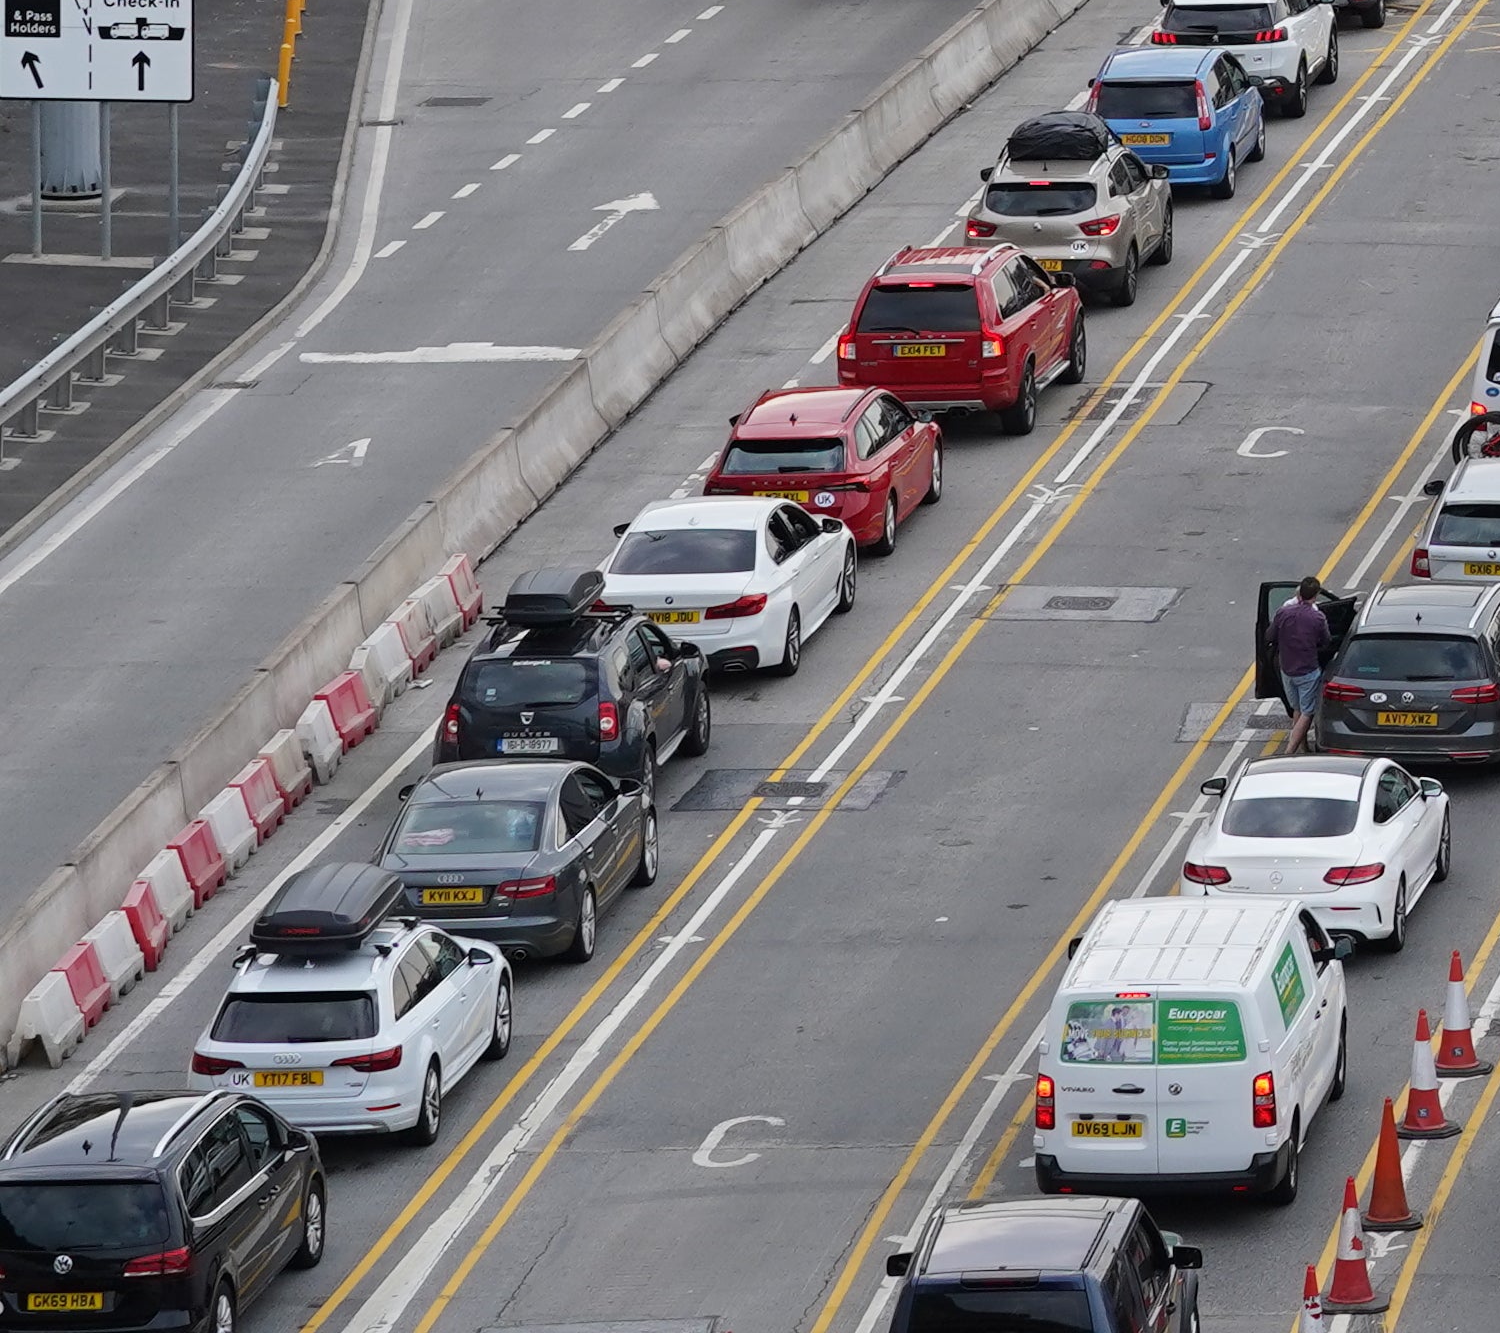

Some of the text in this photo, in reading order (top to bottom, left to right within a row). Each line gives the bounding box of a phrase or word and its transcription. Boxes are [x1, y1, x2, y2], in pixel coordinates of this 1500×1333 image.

[13, 9, 53, 23] & Pass
[10, 21, 57, 36] Holders
[1073, 242, 1086, 252] UK
[900, 344, 942, 355] EX14 FET
[1236, 426, 1305, 459] C
[818, 495, 832, 505] UK
[1469, 564, 1492, 575] GX16
[1384, 714, 1432, 727] AV17 XWZ
[428, 890, 476, 902] KY11 KXJ
[1167, 1007, 1228, 1023] Europcar
[232, 1072, 250, 1085] UK
[261, 1071, 318, 1086] YT17 FBL
[1060, 1085, 1096, 1094] VIVARO
[1077, 1123, 1138, 1137] DV69 LJN
[691, 1115, 786, 1169] C
[35, 1294, 97, 1308] GK69 HBA
